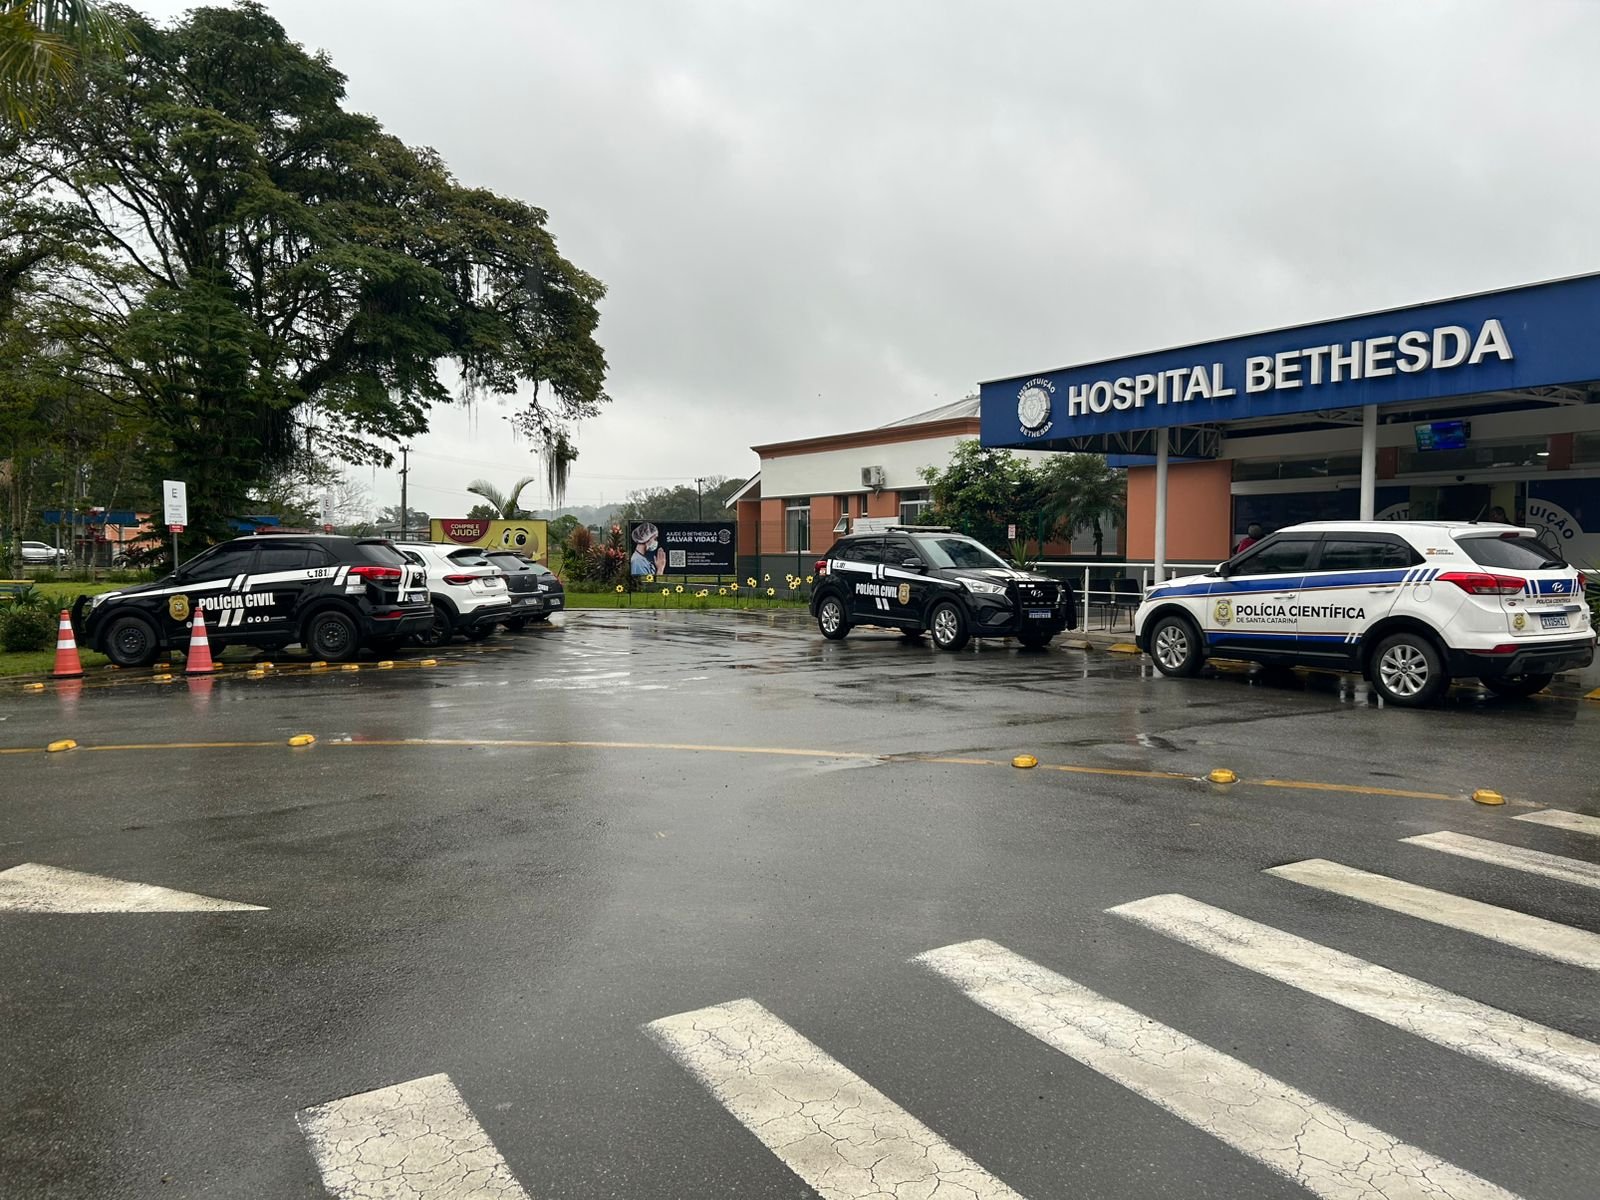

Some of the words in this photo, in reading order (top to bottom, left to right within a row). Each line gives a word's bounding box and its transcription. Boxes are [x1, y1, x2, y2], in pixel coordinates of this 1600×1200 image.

[1068, 363, 1236, 416] HOSPITAL
[1246, 319, 1514, 393] BETHESDA
[1020, 421, 1053, 438] BETHESDA
[172, 488, 178, 498] E
[1530, 505, 1574, 539] UIÇÃO
[314, 568, 328, 578] 181
[855, 582, 880, 596] POLÍCIA
[880, 585, 898, 598] CIVIL
[198, 594, 244, 611] POLÍCIA
[245, 592, 276, 607] CIVIL
[1236, 603, 1286, 617] POLÍCIA
[1289, 604, 1366, 619] CIENTÍFICA
